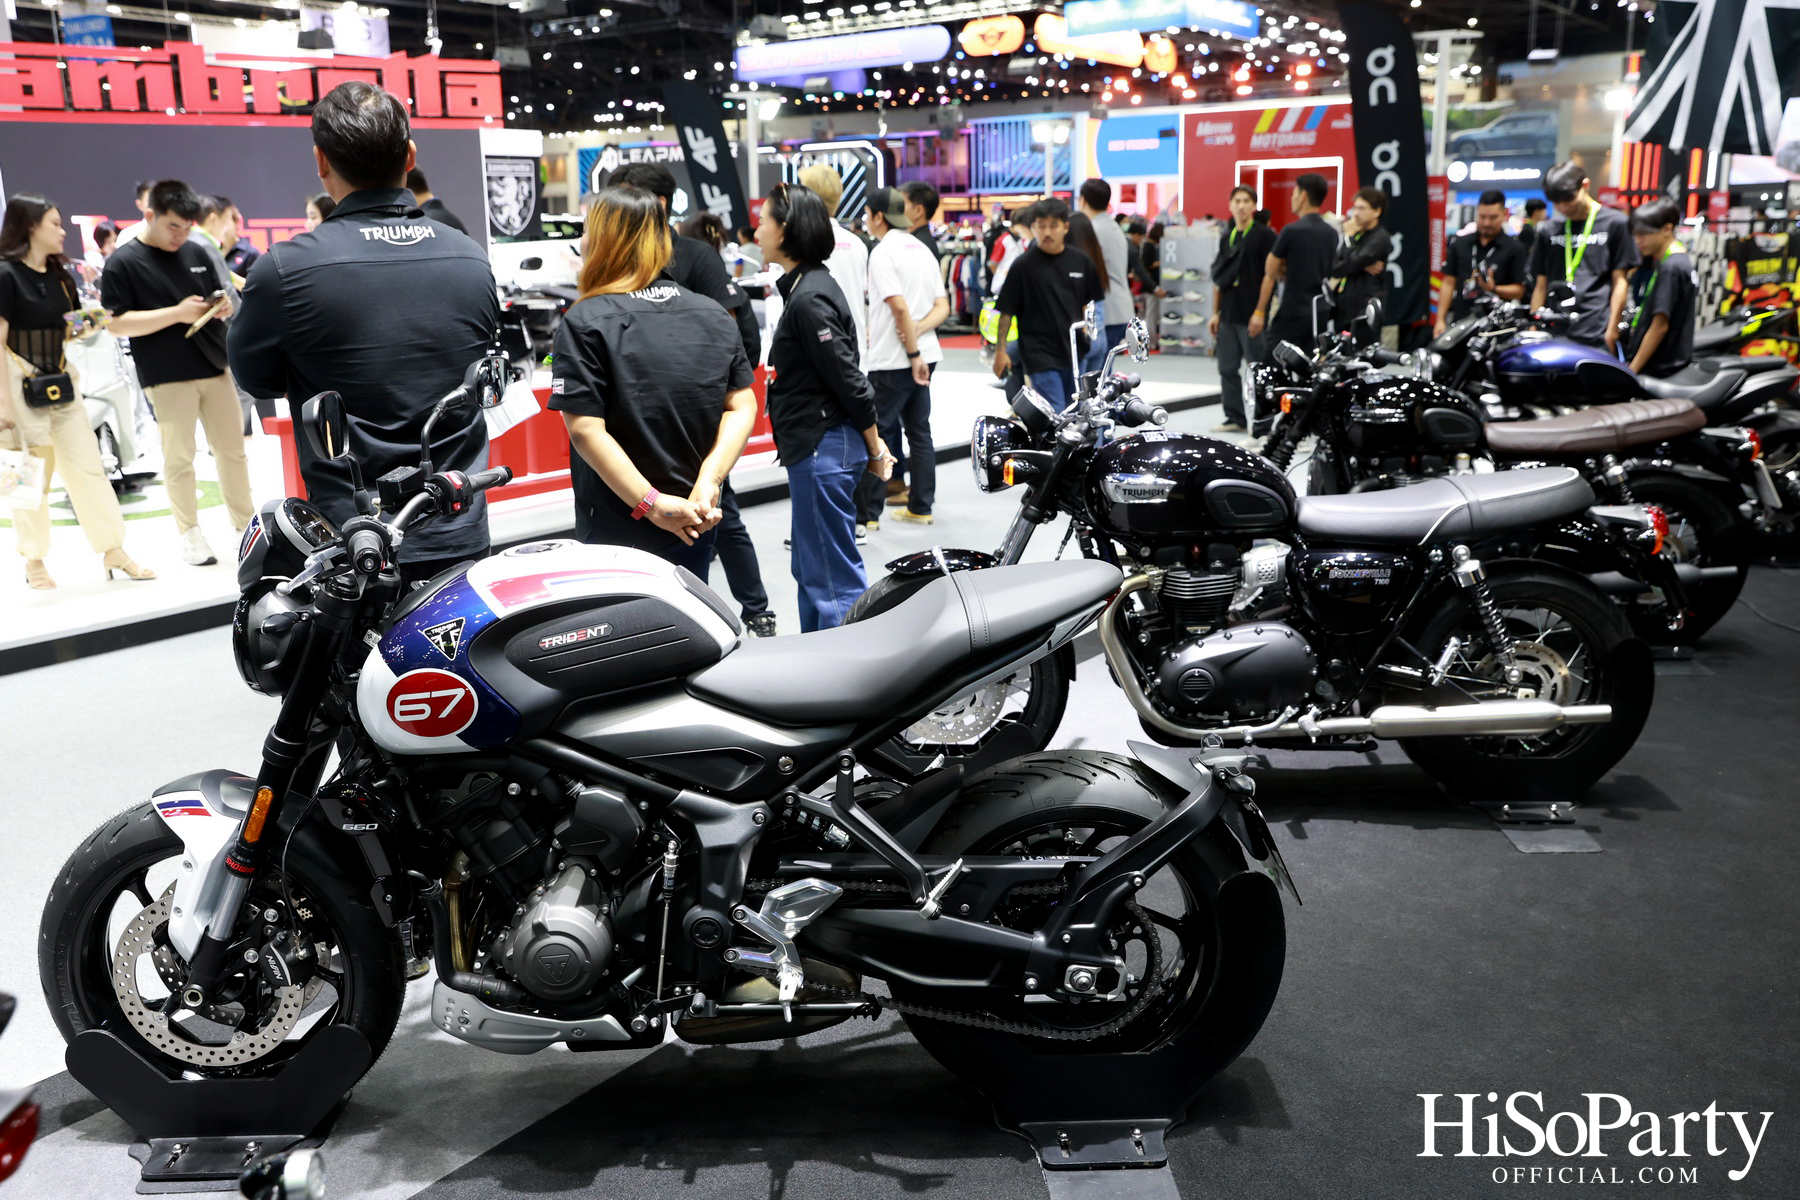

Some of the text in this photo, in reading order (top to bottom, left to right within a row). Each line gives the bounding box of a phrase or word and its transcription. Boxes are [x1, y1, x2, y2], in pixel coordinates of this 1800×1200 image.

[359, 225, 436, 245] TRIUMPH
[626, 286, 681, 302] TRIUMPH
[1122, 488, 1164, 499] TRIUMPH
[1329, 568, 1391, 579] BONNEVILLE
[430, 622, 457, 635] TRIUMPH
[541, 624, 608, 648] TRIDENT
[394, 687, 466, 722] 67
[342, 823, 379, 831] 660
[225, 857, 255, 873] SHOWA
